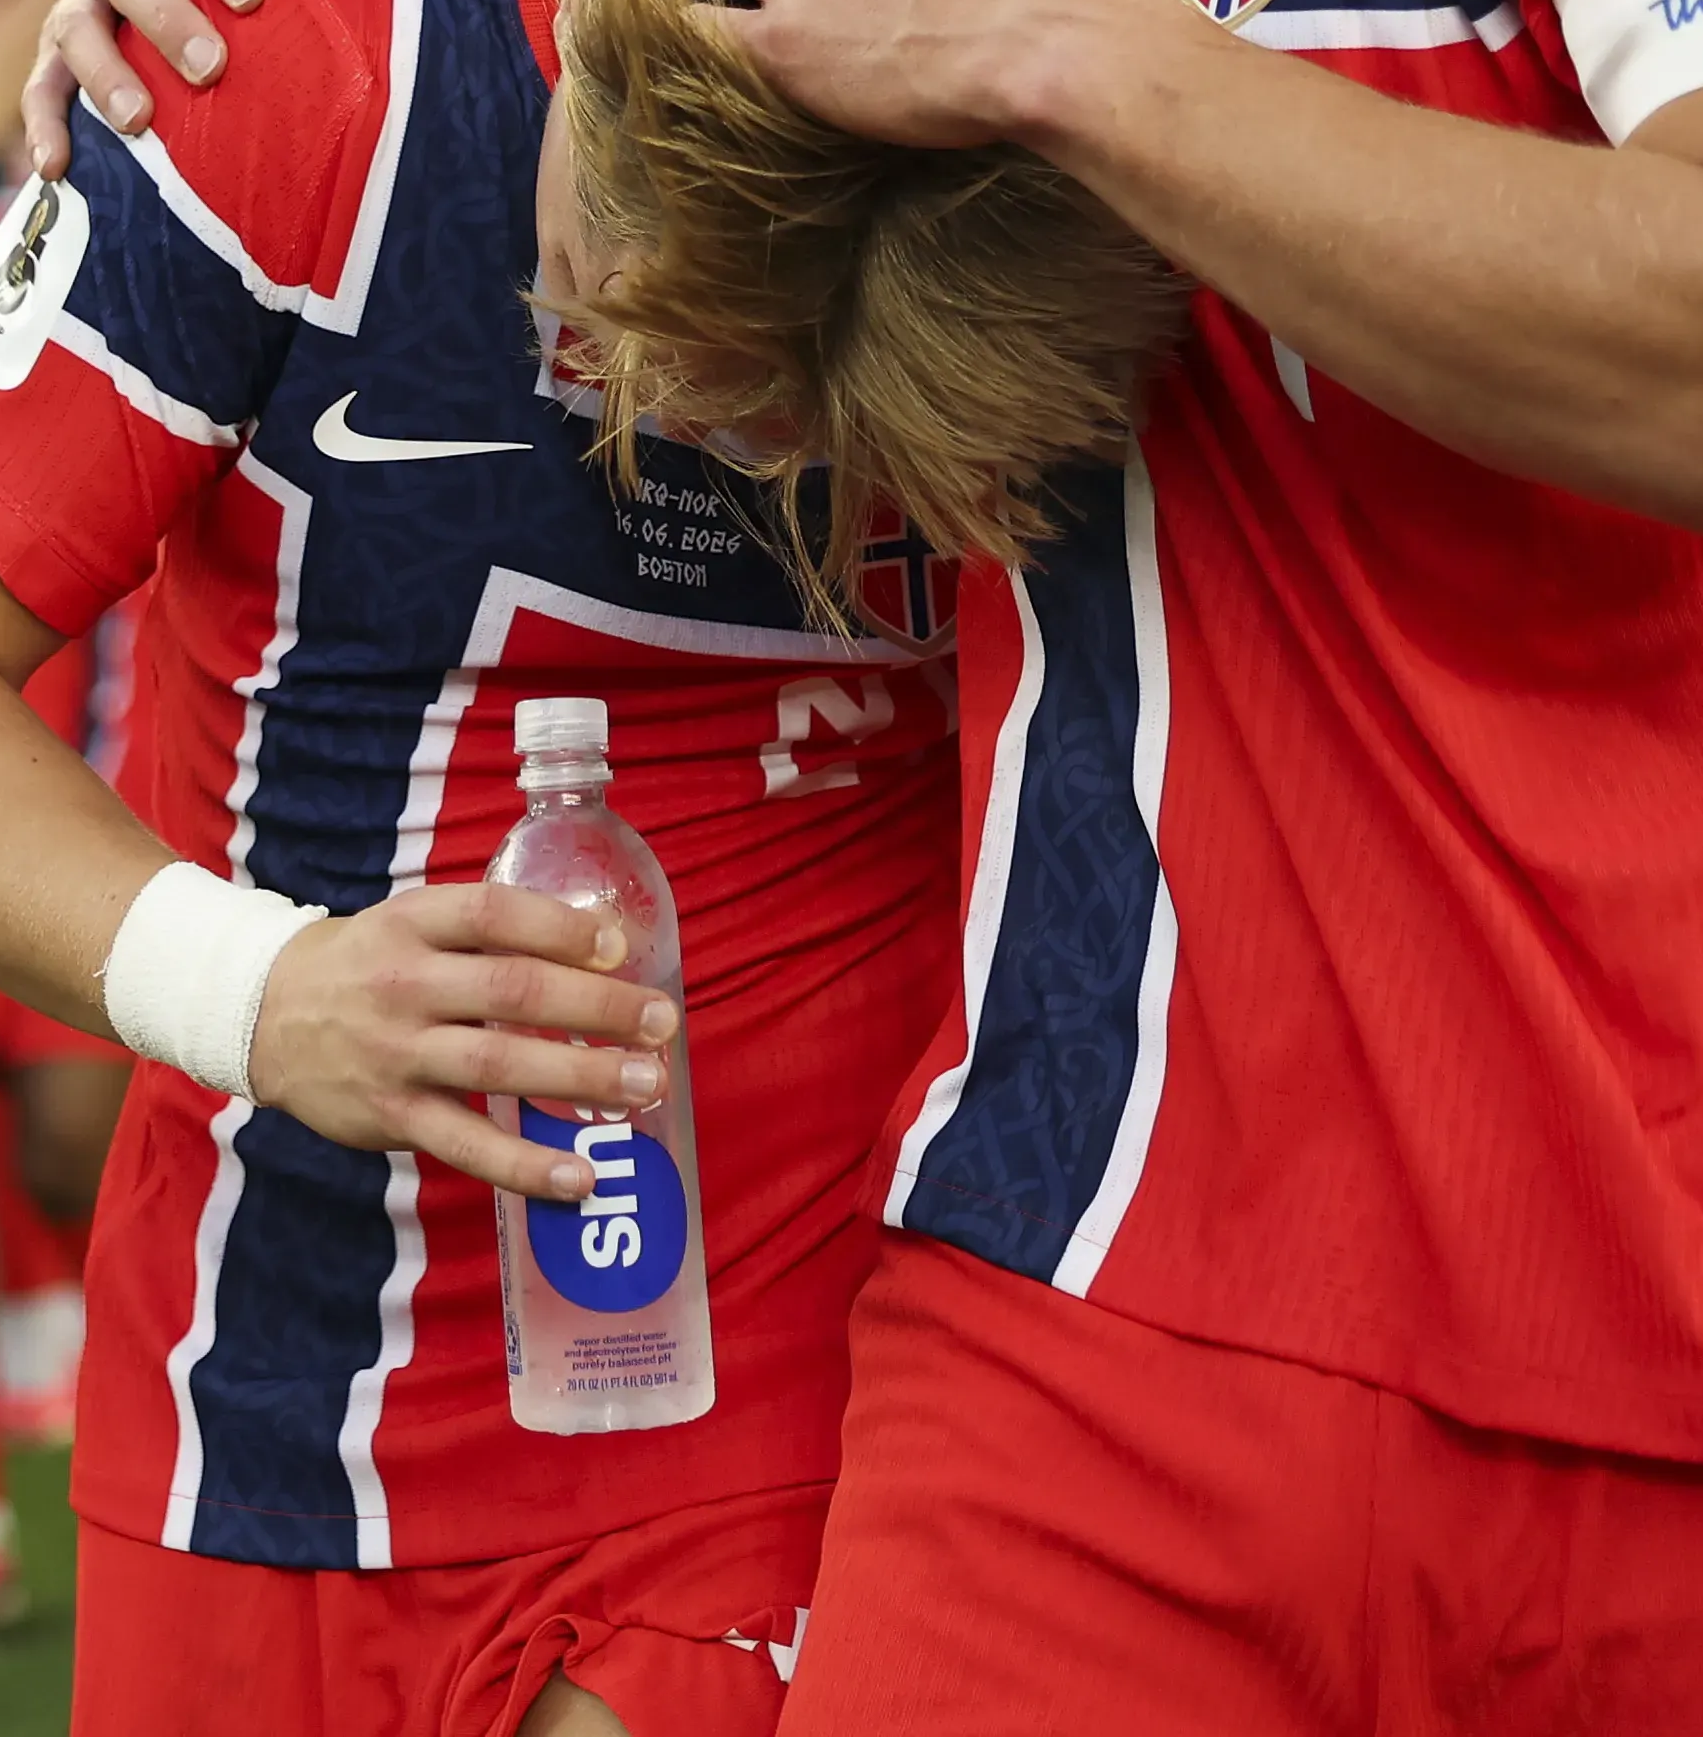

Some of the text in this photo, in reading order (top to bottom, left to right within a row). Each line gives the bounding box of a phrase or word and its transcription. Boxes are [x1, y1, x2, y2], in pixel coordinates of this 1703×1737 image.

[637, 552, 708, 588] BOSTON
[564, 1347, 581, 1358] and
[642, 1343, 656, 1353] for
[572, 1353, 671, 1372] purely balanced pH
[567, 1378, 577, 1392] 20
[579, 1378, 588, 1391] FL
[588, 1377, 599, 1391] OZ
